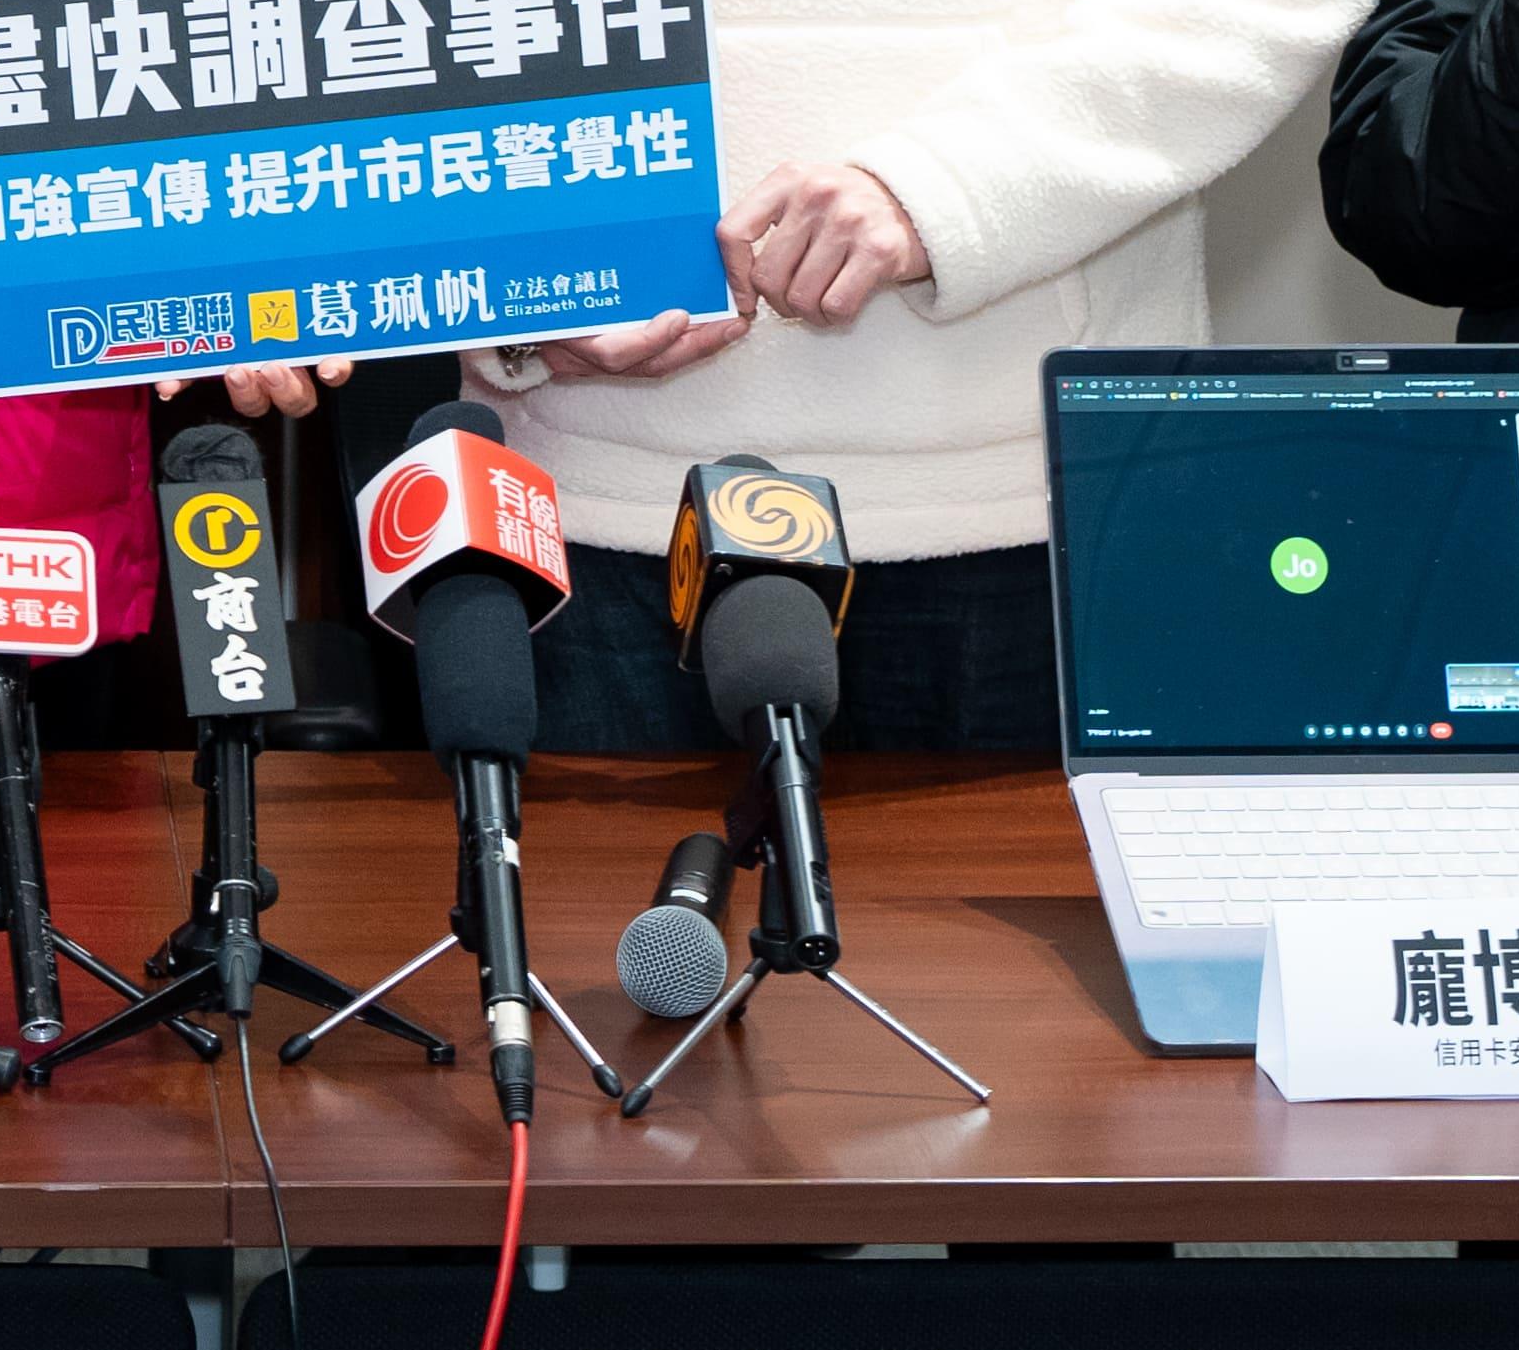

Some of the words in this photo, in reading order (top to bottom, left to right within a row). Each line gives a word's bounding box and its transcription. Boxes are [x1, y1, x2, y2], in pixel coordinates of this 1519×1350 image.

[228, 109, 693, 218] 提升市民警覺性
[107, 292, 234, 341] 民建聯
[303, 267, 495, 338] 葛珮帆
[504, 268, 619, 300] 立法會議員
[505, 299, 578, 317] Elizabeth
[583, 295, 621, 310] Quat
[170, 336, 235, 355] DAB
[1283, 552, 1317, 579] Jo
[192, 571, 267, 702] 商台
